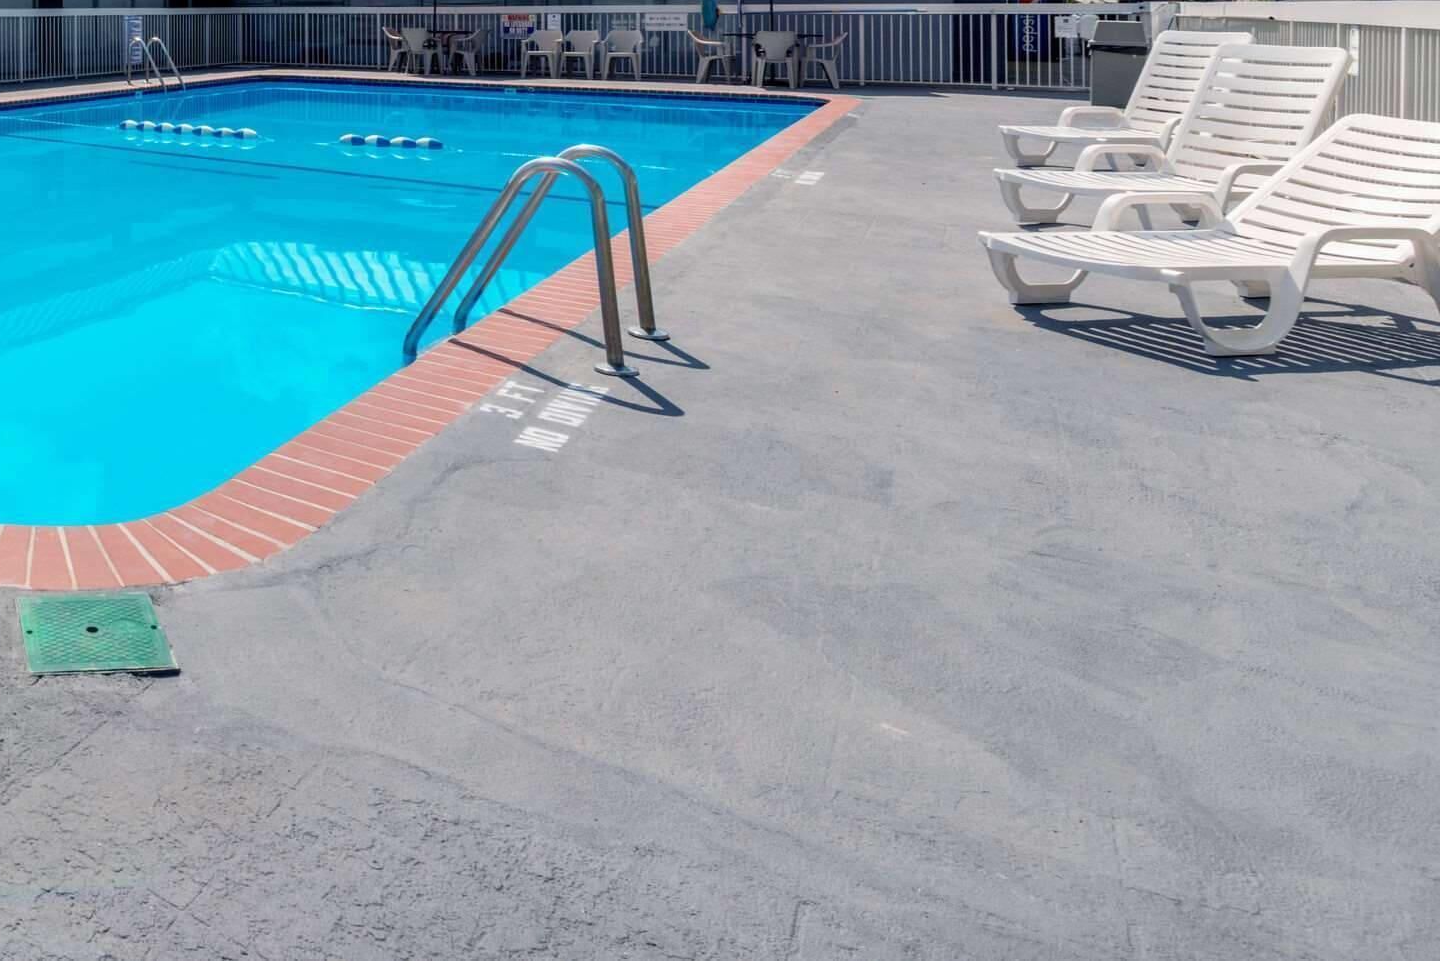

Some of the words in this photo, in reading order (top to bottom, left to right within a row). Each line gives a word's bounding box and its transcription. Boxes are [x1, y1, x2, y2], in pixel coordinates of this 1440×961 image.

[496, 381, 545, 403] FT
[479, 403, 524, 419] 3
[514, 426, 569, 453] NO
